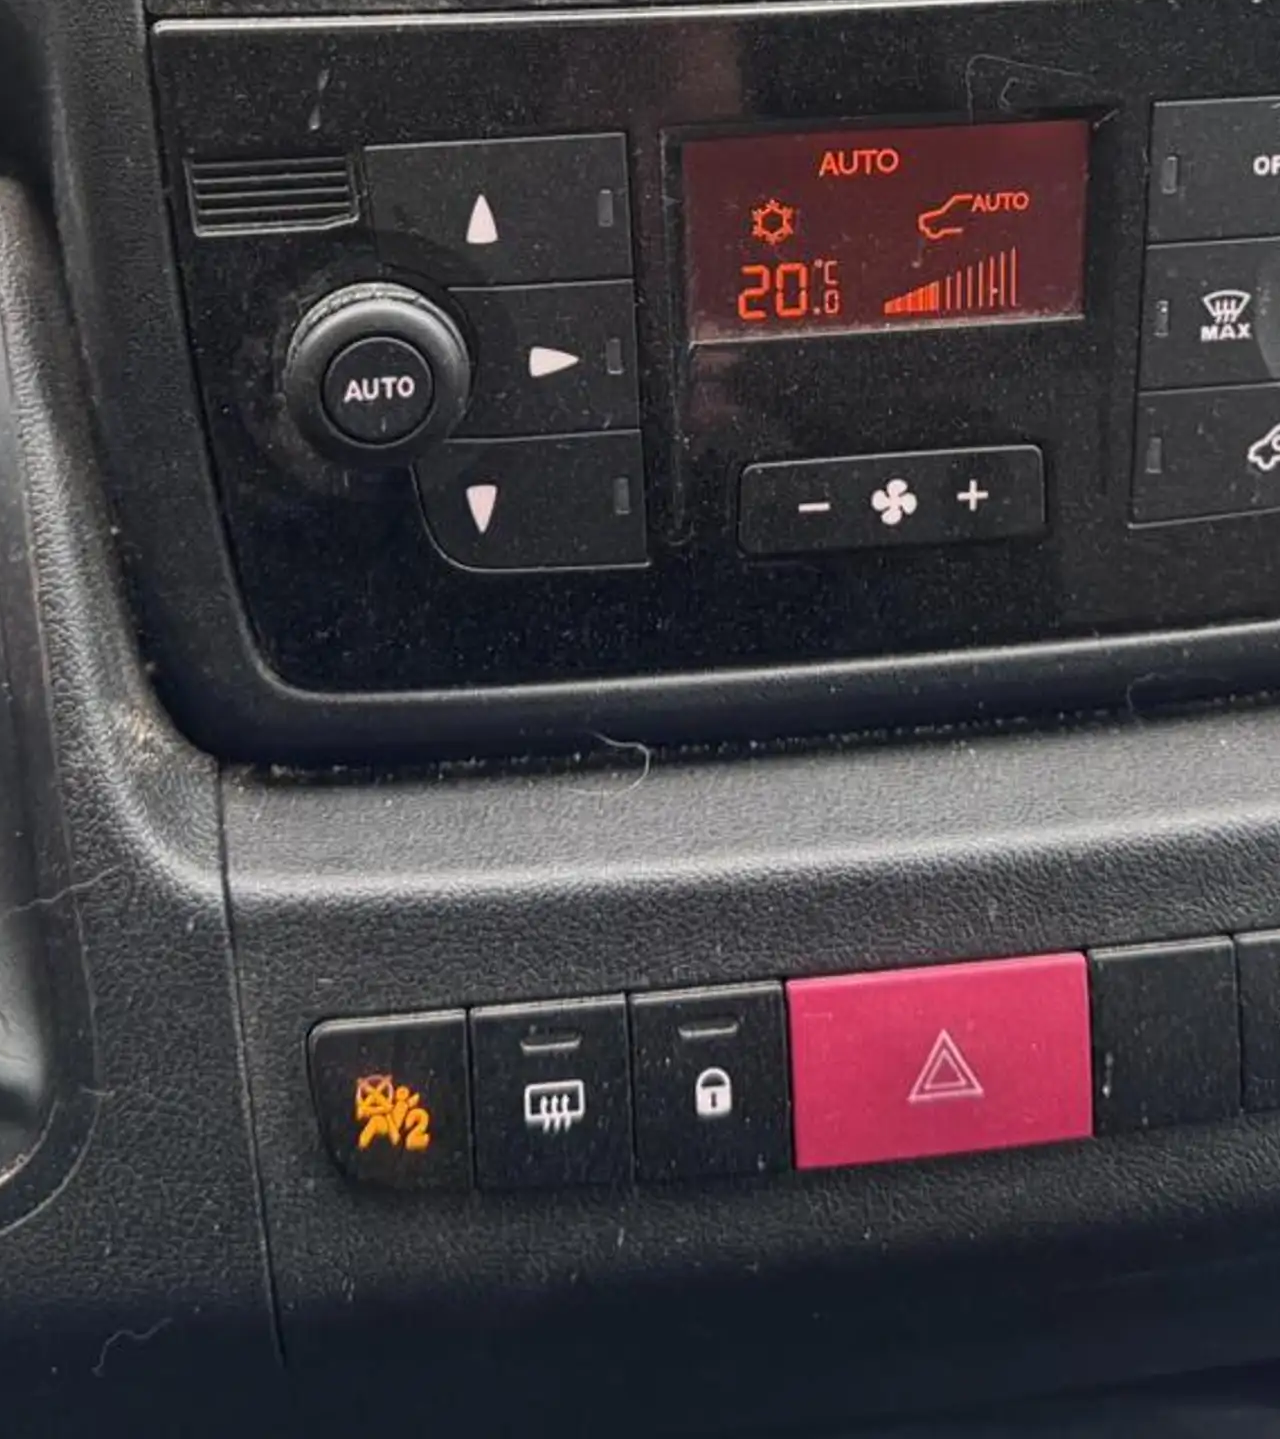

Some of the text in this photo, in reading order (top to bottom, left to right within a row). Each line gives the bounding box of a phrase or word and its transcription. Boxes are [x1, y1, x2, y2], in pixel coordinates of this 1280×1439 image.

[819, 147, 900, 177] AUTO
[970, 191, 1030, 213] AUTO
[1200, 322, 1252, 343] MAX
[343, 374, 415, 403] AUTO
